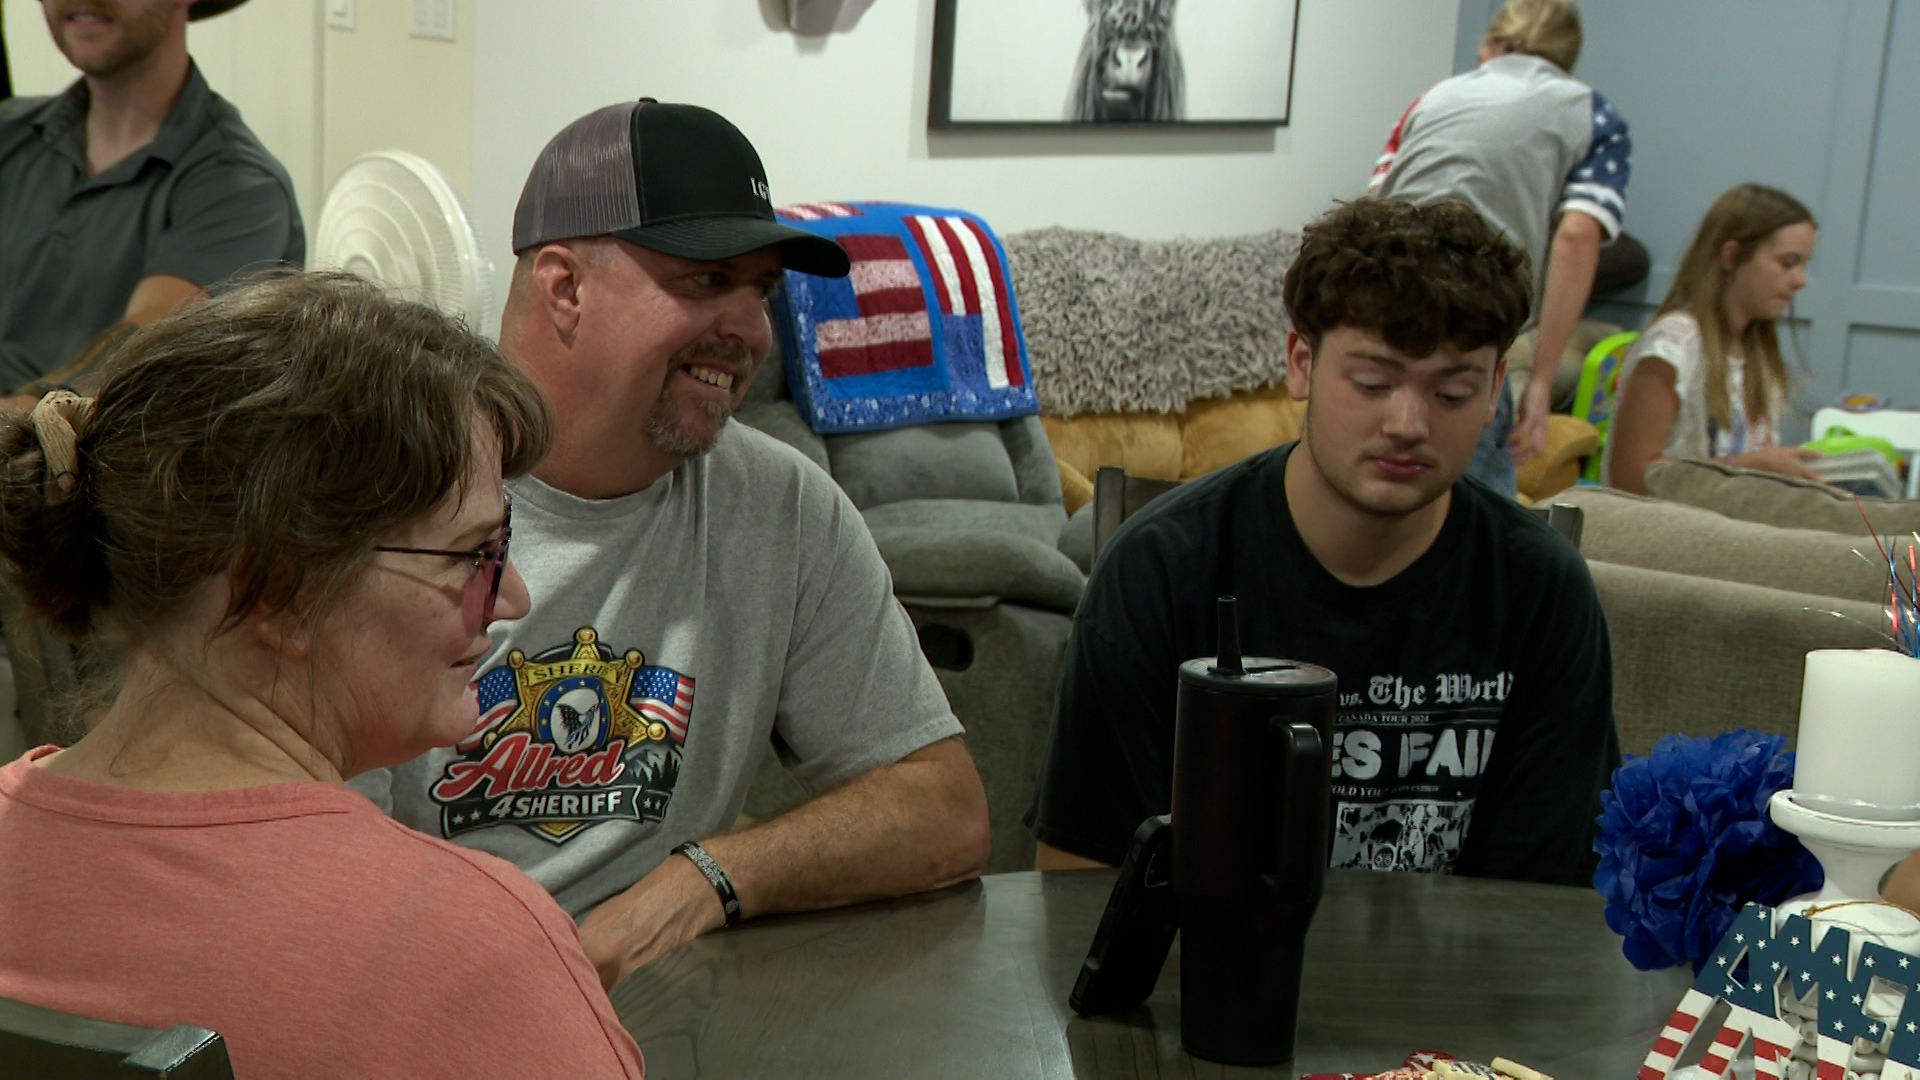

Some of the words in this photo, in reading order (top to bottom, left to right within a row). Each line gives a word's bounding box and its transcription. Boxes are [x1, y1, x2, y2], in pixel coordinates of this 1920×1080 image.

[1367, 673, 1428, 710] The
[433, 733, 625, 800] Allred
[488, 790, 623, 819] 4SHERIFF
